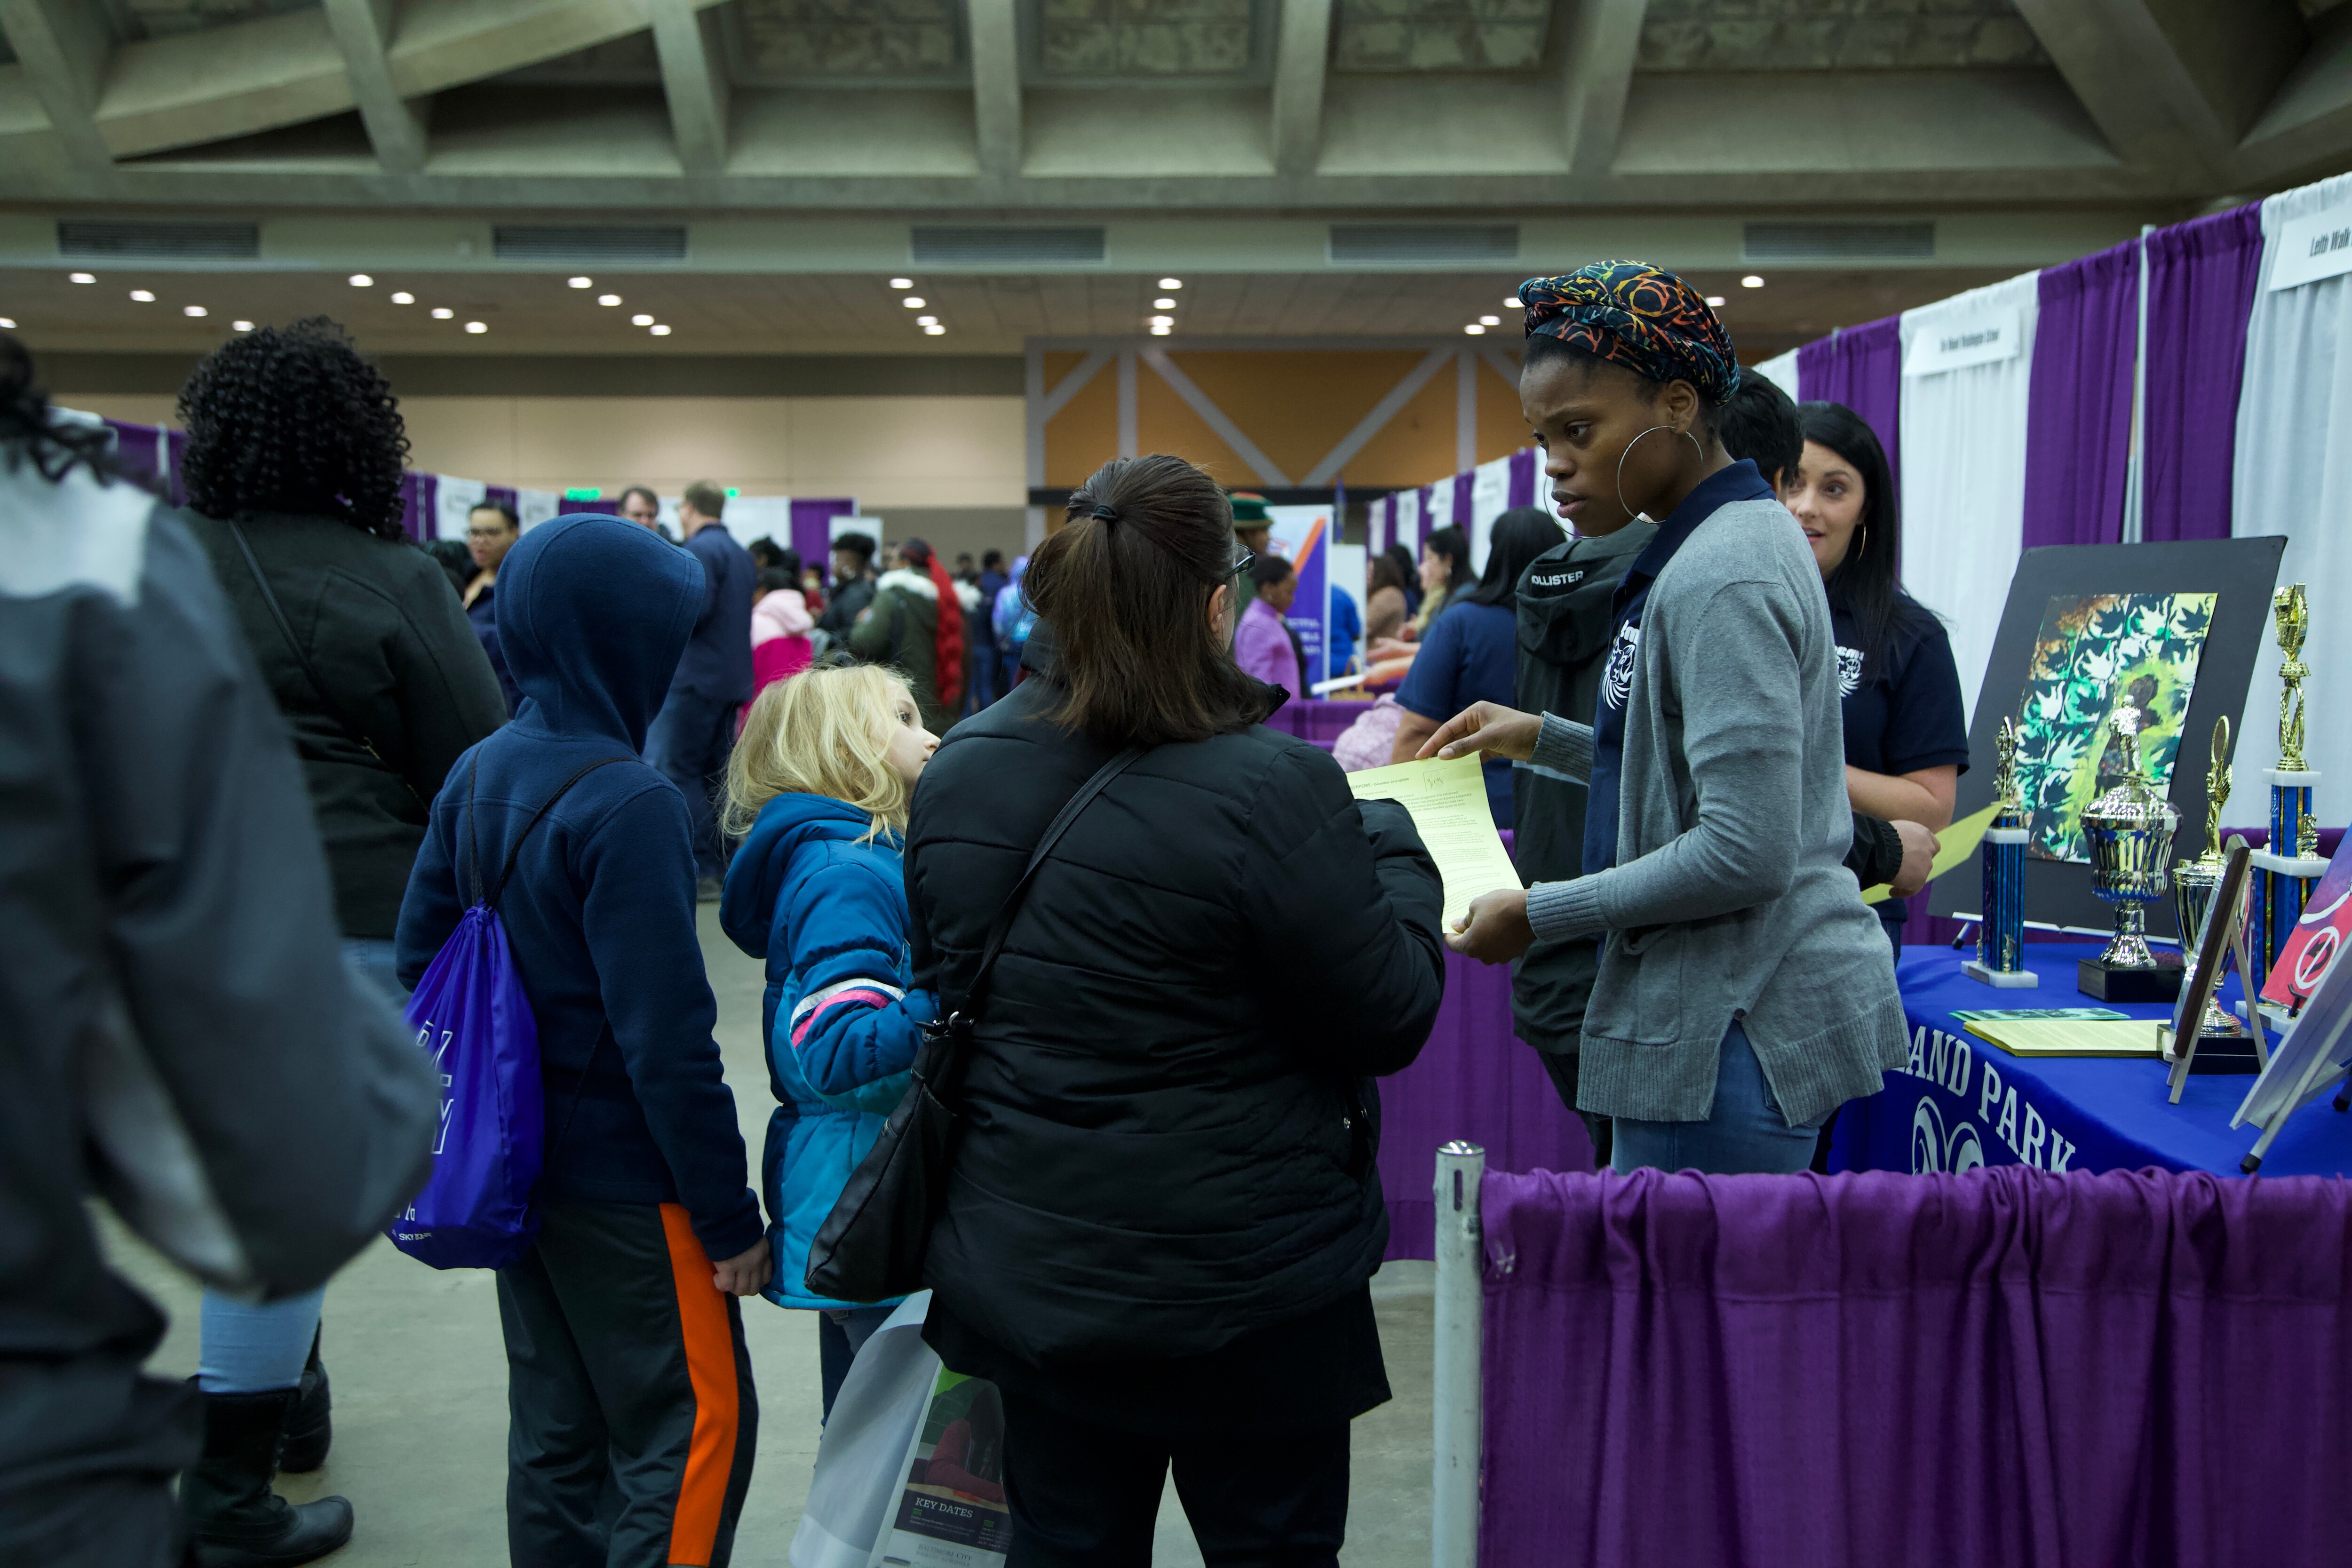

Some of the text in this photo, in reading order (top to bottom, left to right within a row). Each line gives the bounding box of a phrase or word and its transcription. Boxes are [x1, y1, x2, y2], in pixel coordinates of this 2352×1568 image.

[2310, 227, 2351, 257] Leith Walk
[1531, 570, 1583, 586] OLLISTER
[1891, 1026, 2076, 1175] AND PARK
[915, 1497, 974, 1518] KEY DATES
